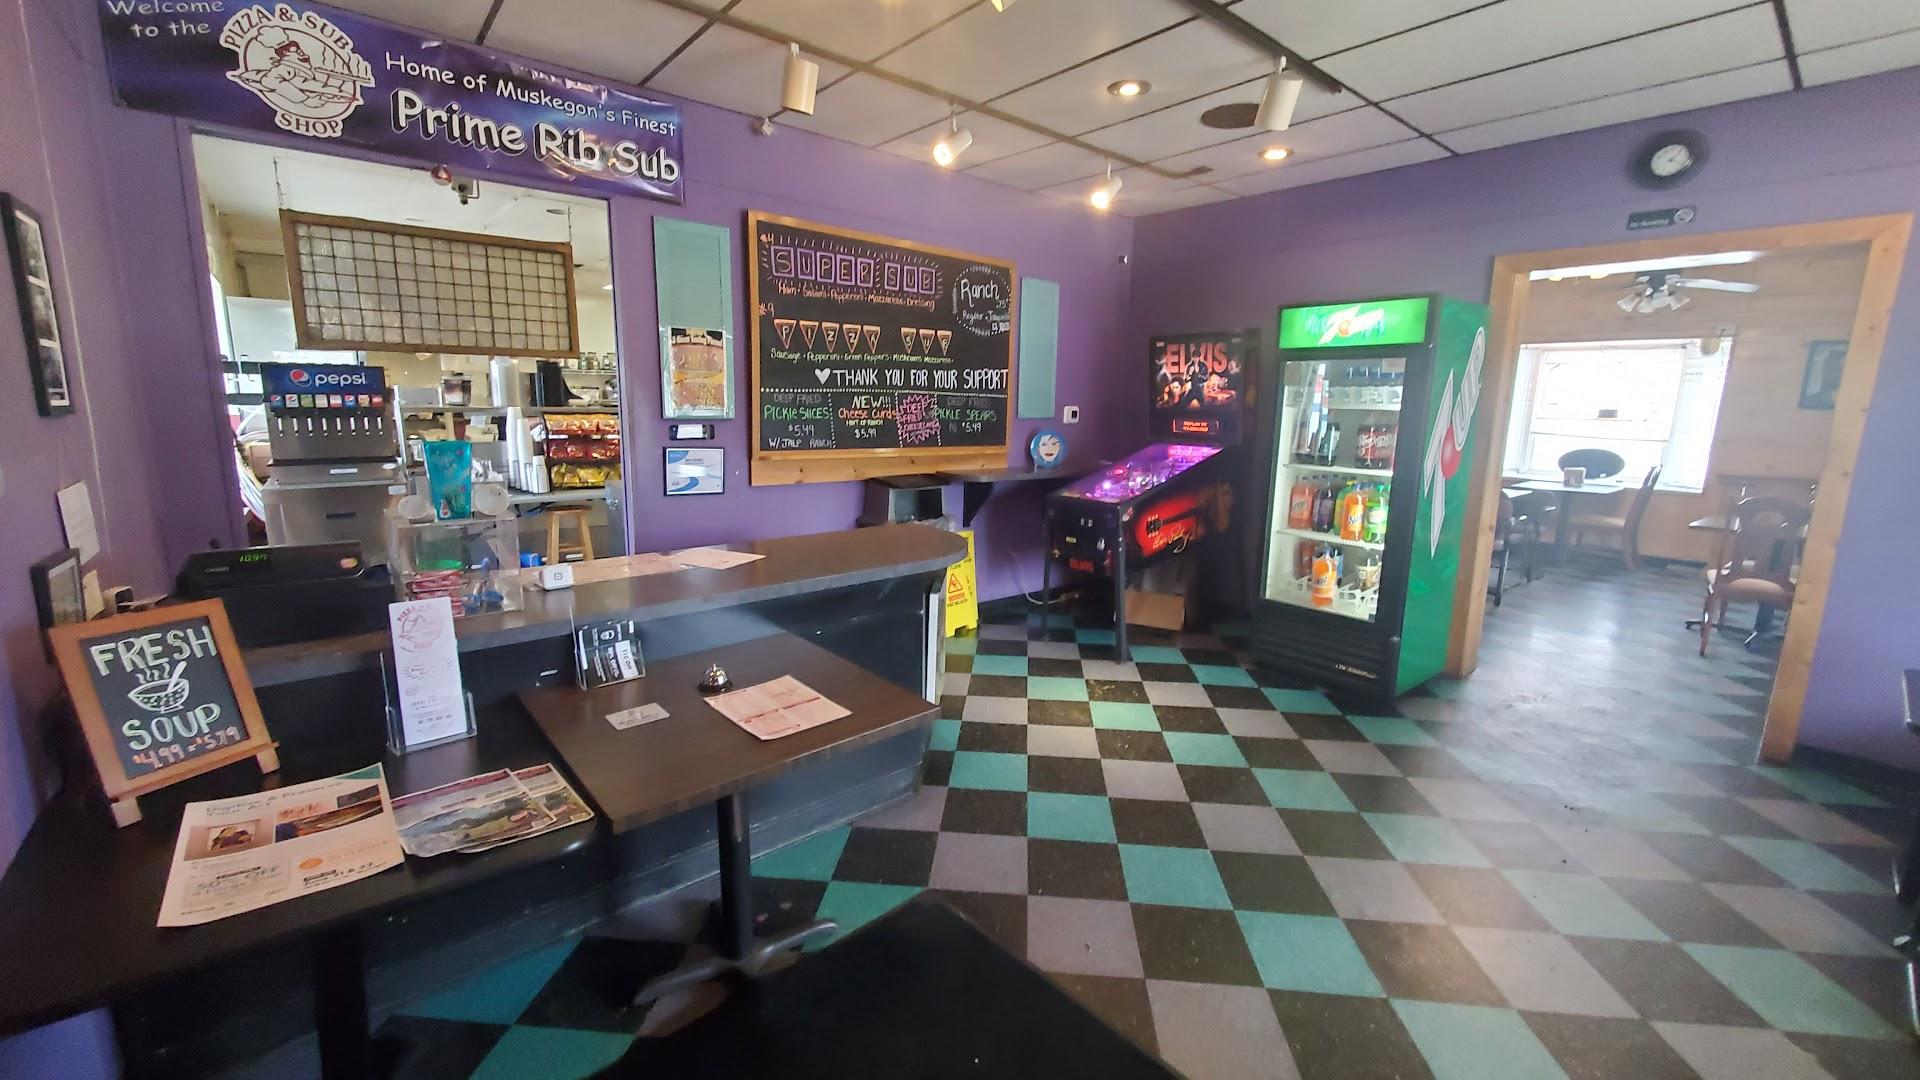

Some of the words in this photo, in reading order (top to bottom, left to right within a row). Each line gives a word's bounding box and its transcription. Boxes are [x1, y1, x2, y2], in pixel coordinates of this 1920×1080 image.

[107, 0, 225, 15] Welcome
[130, 23, 159, 38] to
[168, 20, 211, 36] the
[224, 8, 273, 49] PIZZA
[279, 7, 295, 22] &
[304, 14, 350, 50] SUB
[385, 51, 455, 85] Home
[463, 74, 487, 93] of
[496, 78, 616, 123] Muskegon's
[622, 110, 676, 137] Finest
[279, 112, 340, 135] SHOP
[394, 89, 527, 153] Prime
[537, 122, 601, 166] Rib
[612, 142, 680, 182] Sub
[887, 266, 932, 291] SUB
[961, 278, 1000, 308] Ranch
[781, 324, 878, 345] PIZZA
[770, 347, 801, 364] Sausage
[807, 351, 840, 364] Pepperoni
[863, 353, 890, 364] Peppers
[315, 372, 366, 388] pepsi
[833, 368, 879, 386] THANK
[885, 368, 904, 387] YOU
[910, 369, 928, 387] FOR
[933, 369, 958, 389] YOUR
[963, 368, 1008, 389] SUPPORT
[773, 393, 794, 403] DEEP
[797, 393, 822, 405] FRIED
[851, 395, 892, 409] NEW!!!
[947, 396, 964, 406] DEEP
[838, 407, 868, 420] Cheese
[871, 407, 897, 420] Curds
[902, 413, 923, 424] FRIED
[934, 407, 961, 420] PICKLE
[788, 424, 815, 437] $5.49
[854, 427, 877, 439] $5.99
[961, 421, 982, 433] $5.49
[89, 625, 218, 677] FRESH
[121, 703, 222, 751] SOUP
